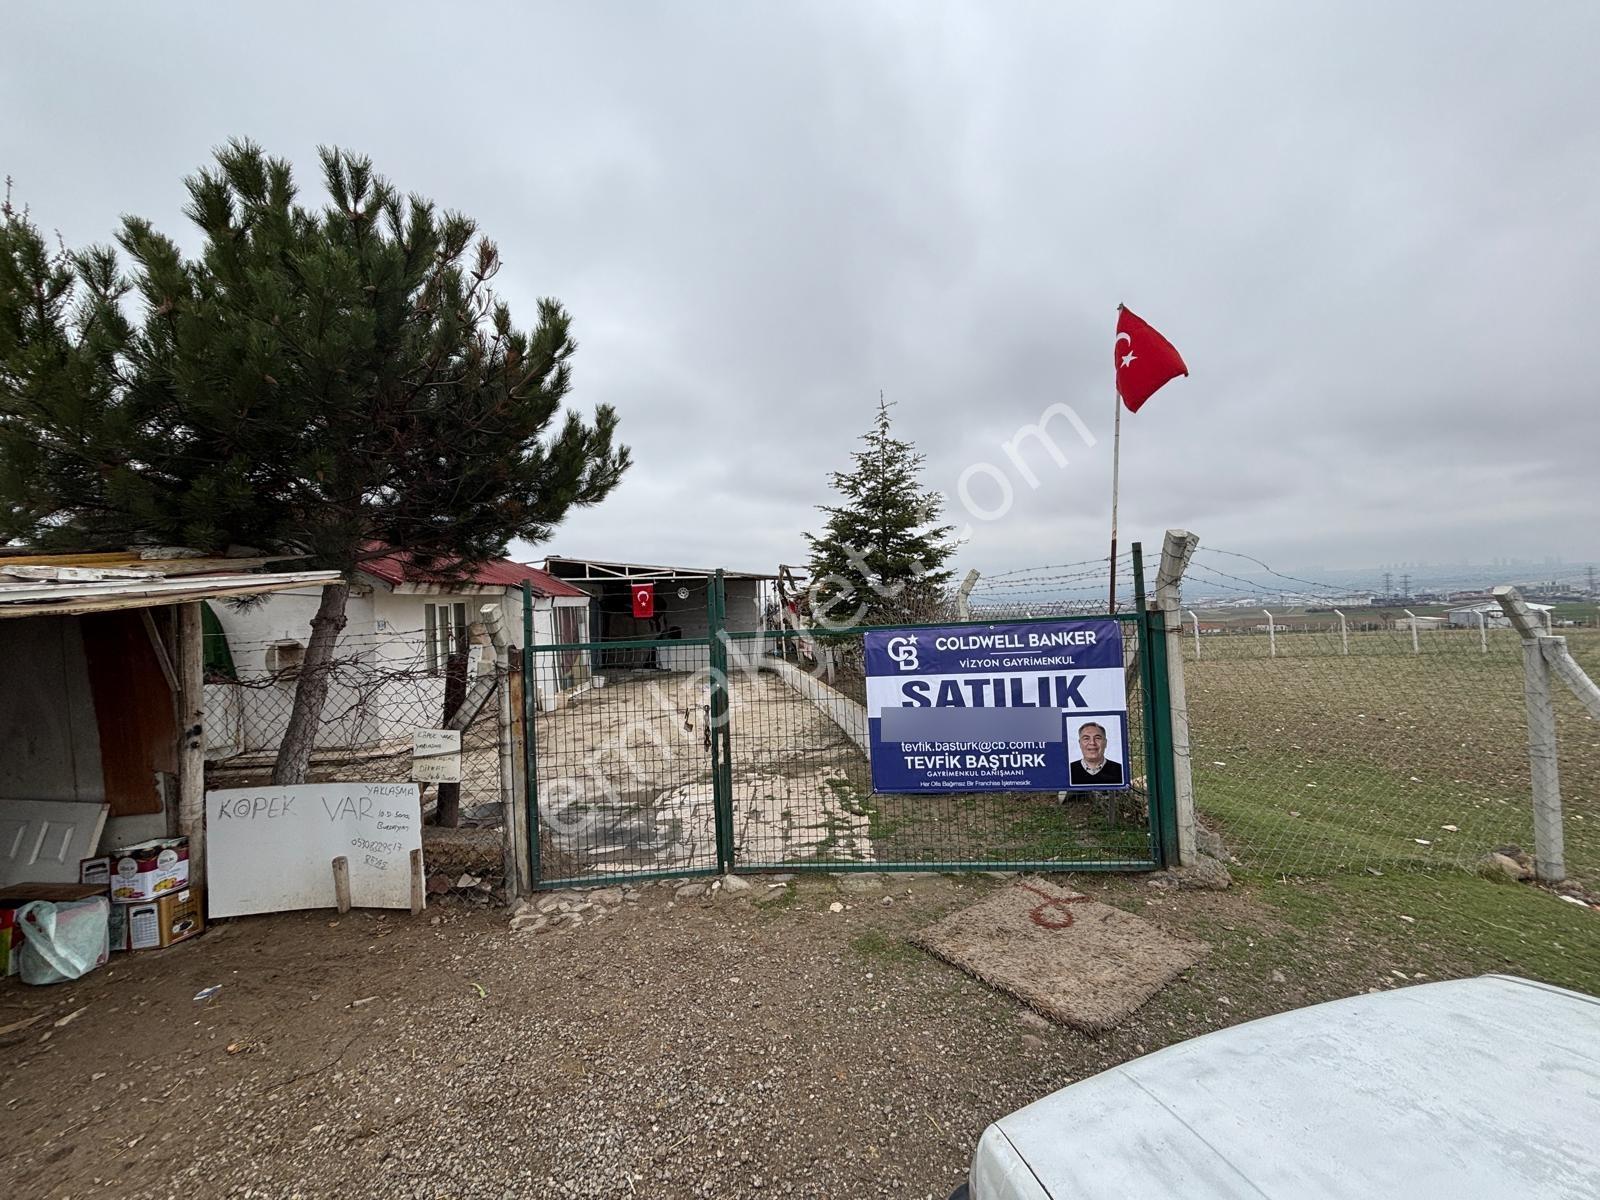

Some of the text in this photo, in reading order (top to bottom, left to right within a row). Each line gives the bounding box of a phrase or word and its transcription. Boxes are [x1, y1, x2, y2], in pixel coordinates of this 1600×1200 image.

[935, 631, 1097, 651] COLDWELL BANKER
[959, 656, 1075, 669] VİZYON GAYRİMENKUL
[901, 674, 1088, 707] SATILIK
[904, 751, 1046, 771] TEVFİK BAŞTÜRK
[926, 770, 979, 778] GAYRİMENKUL
[321, 796, 374, 822] VAR
